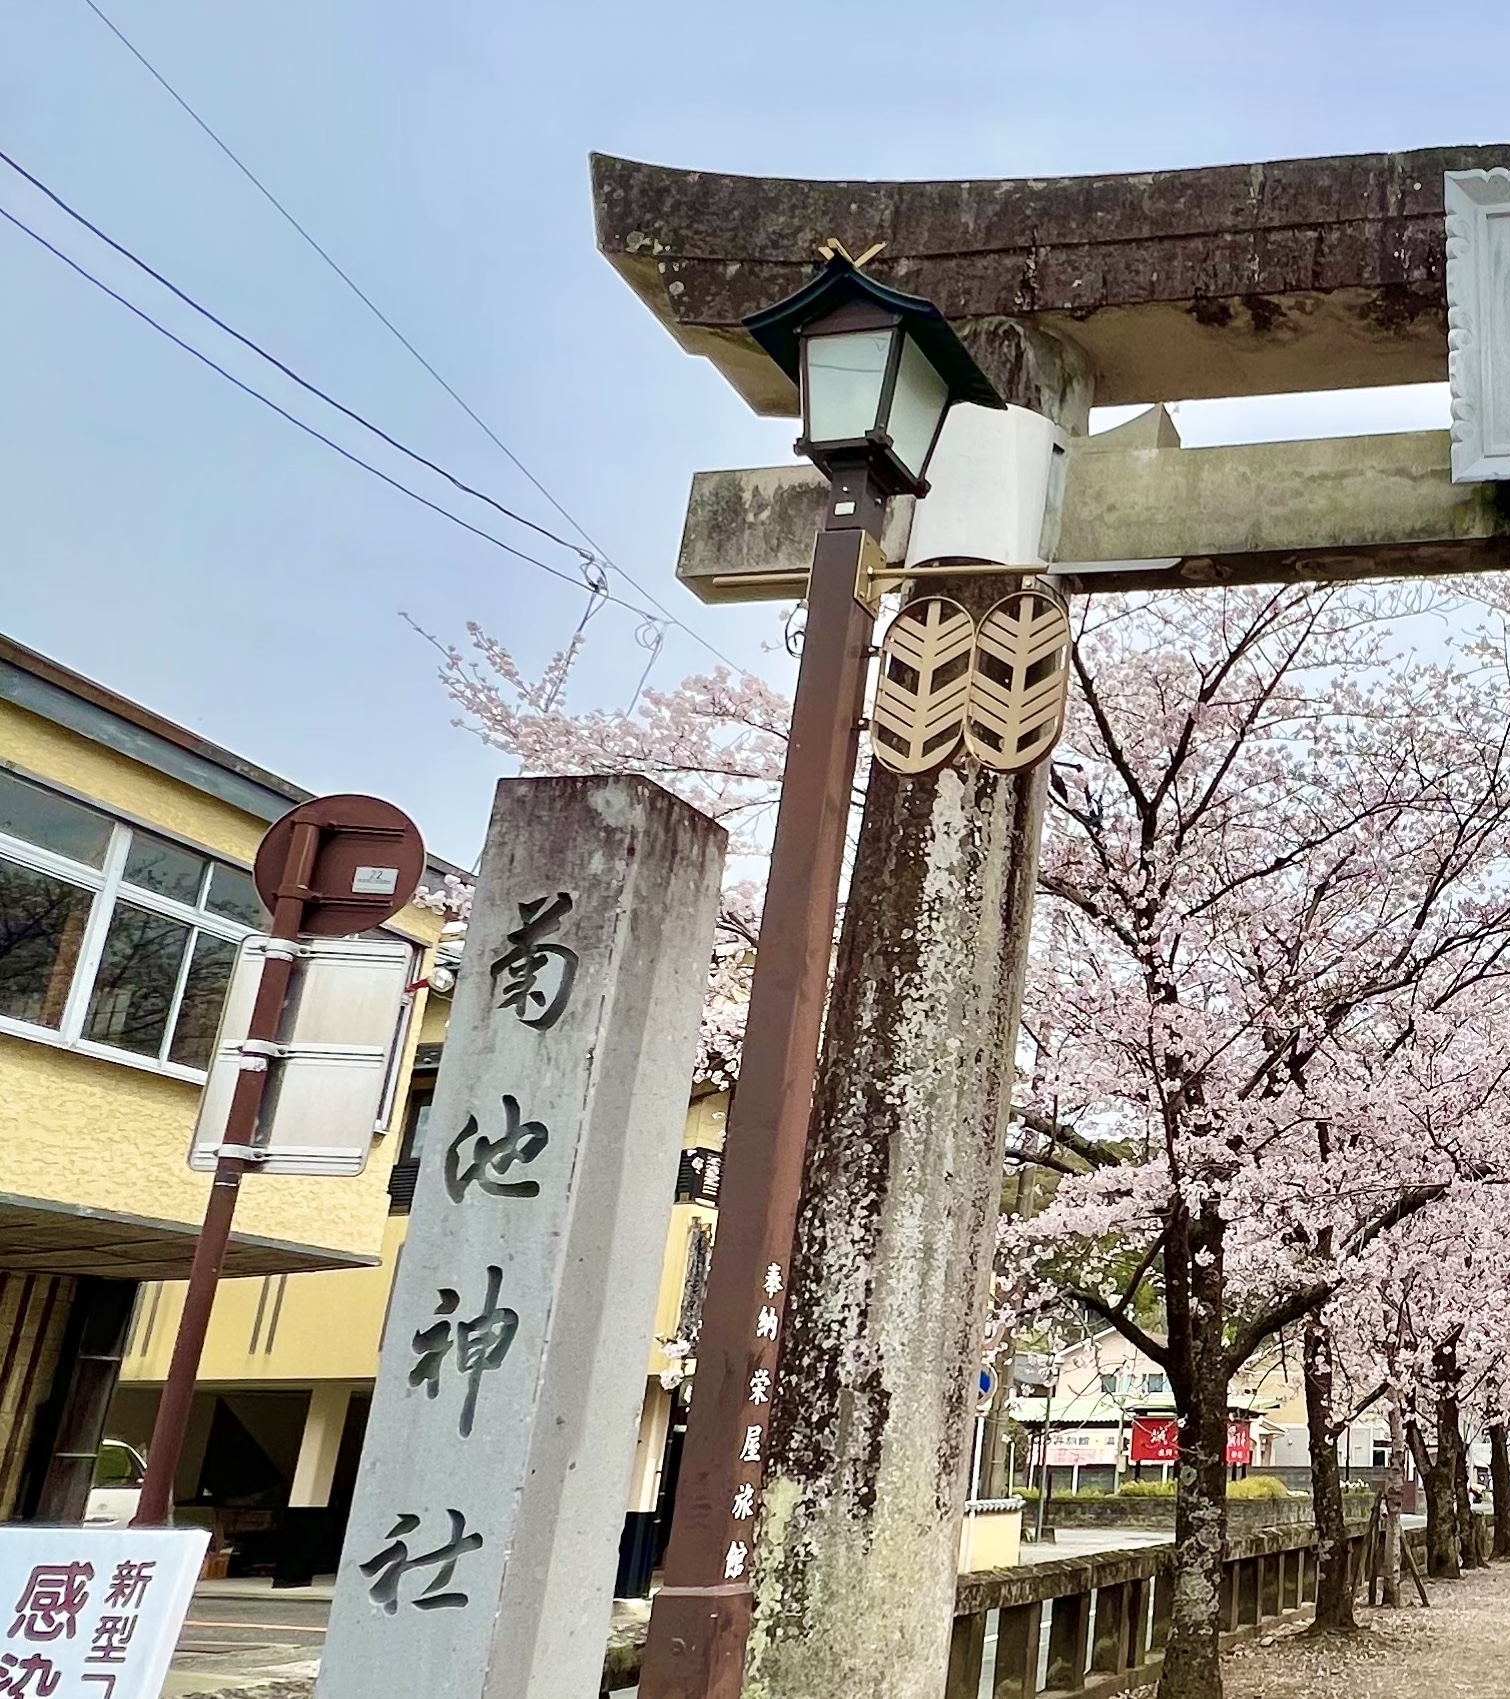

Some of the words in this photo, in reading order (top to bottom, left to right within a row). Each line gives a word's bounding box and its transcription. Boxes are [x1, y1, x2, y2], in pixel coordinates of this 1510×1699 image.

[361, 890, 579, 1616] 菊池神社
[756, 1262, 783, 1341] 奉納
[724, 1368, 772, 1580] 栄屋旅館
